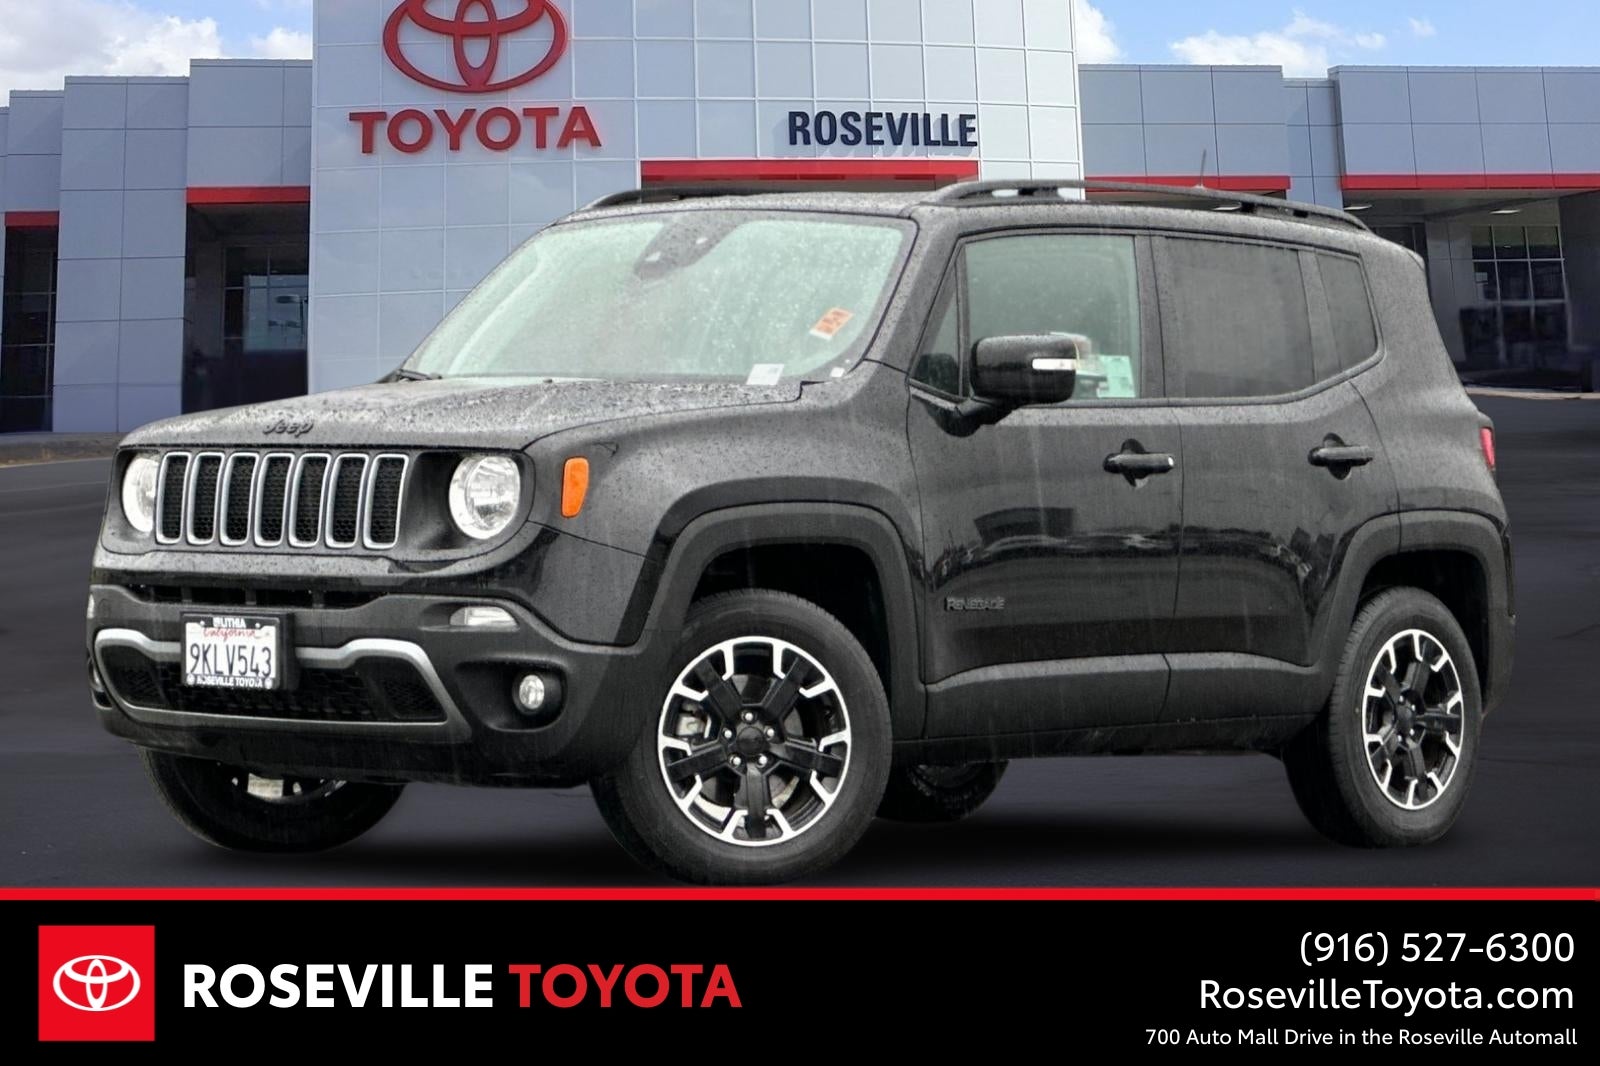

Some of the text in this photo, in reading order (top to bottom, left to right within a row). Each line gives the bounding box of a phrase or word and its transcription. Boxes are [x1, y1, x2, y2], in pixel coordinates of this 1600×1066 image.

[348, 106, 602, 154] TOYOTA
[788, 110, 978, 147] ROSEVILLE
[262, 418, 314, 438] Jeep
[944, 597, 1005, 611] RENEGADE
[190, 643, 272, 677] 9KLV543
[196, 675, 263, 688] ROSEVILLE TOYOTA
